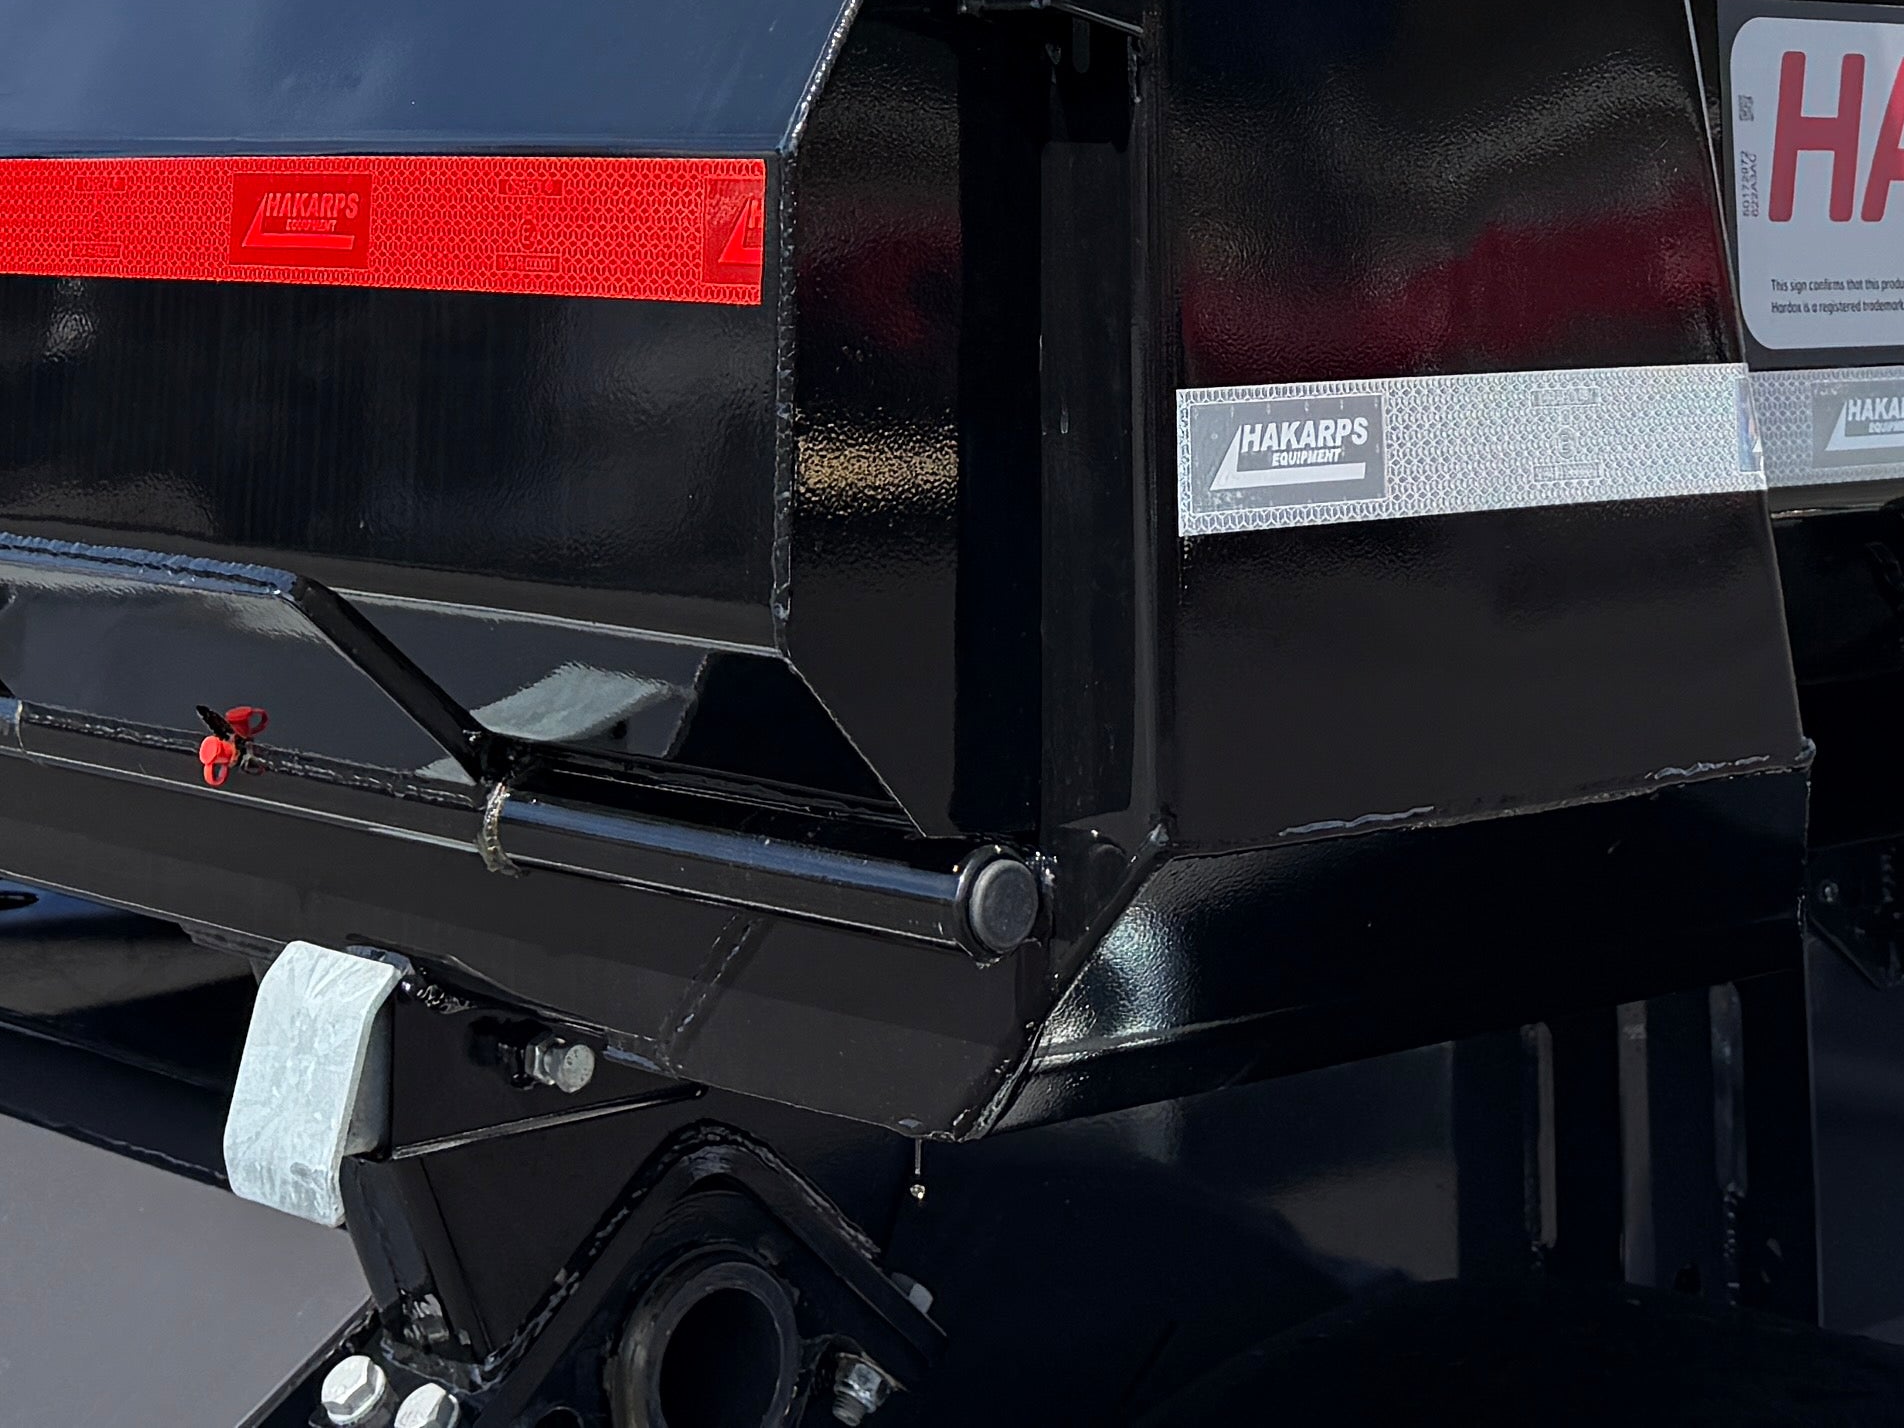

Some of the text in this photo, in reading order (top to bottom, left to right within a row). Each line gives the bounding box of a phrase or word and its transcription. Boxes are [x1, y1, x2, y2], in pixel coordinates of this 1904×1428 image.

[265, 192, 360, 219] HAKARPS
[1771, 279, 1789, 292] This
[1790, 279, 1807, 294] sign
[1808, 278, 1845, 291] confirms
[1846, 279, 1864, 290] that
[1865, 278, 1880, 290] this
[1771, 301, 1802, 314] Hardox
[1819, 300, 1862, 315] registered
[1862, 299, 1904, 312] trademark
[1240, 416, 1369, 454] HAKARPS
[1271, 448, 1343, 467] EQUIPMENT
